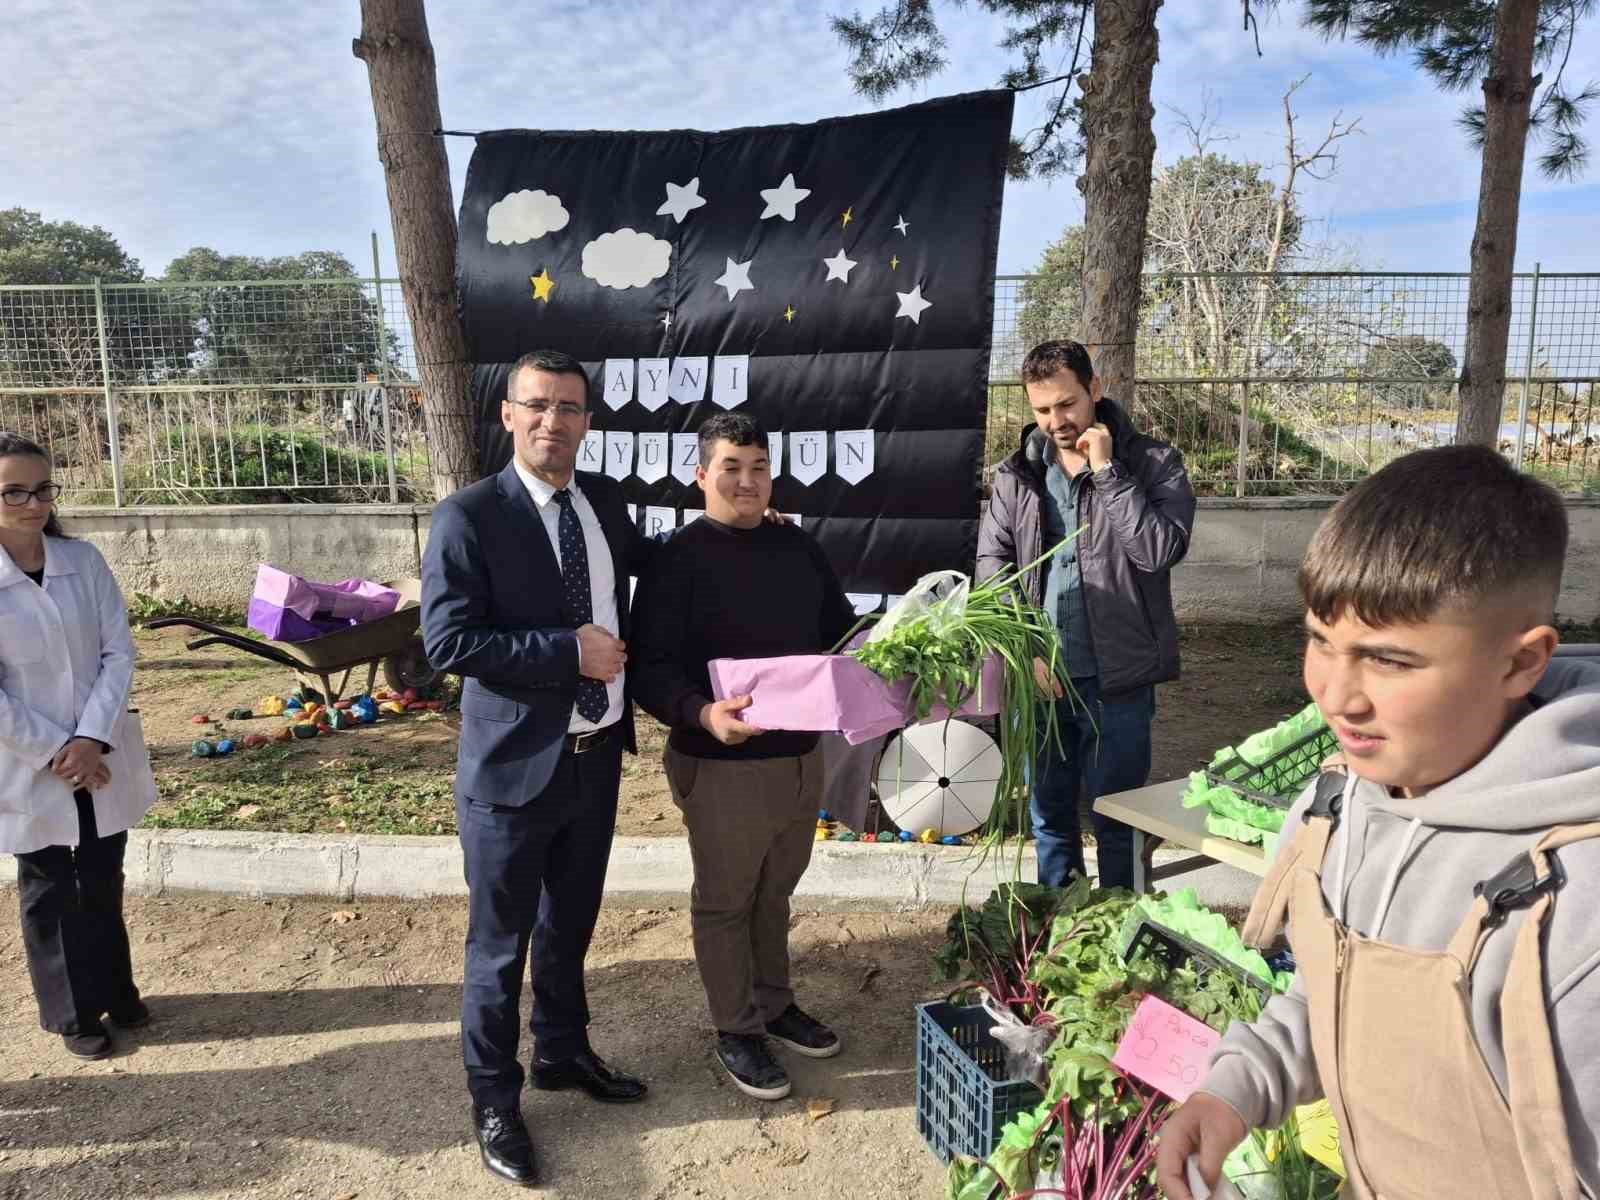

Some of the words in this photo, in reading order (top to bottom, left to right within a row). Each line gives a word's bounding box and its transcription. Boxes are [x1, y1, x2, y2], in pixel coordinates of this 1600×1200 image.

[612, 366, 738, 392] AYNI
[583, 437, 866, 466] KYÜZÜN
[1165, 1054, 1199, 1085] 50
